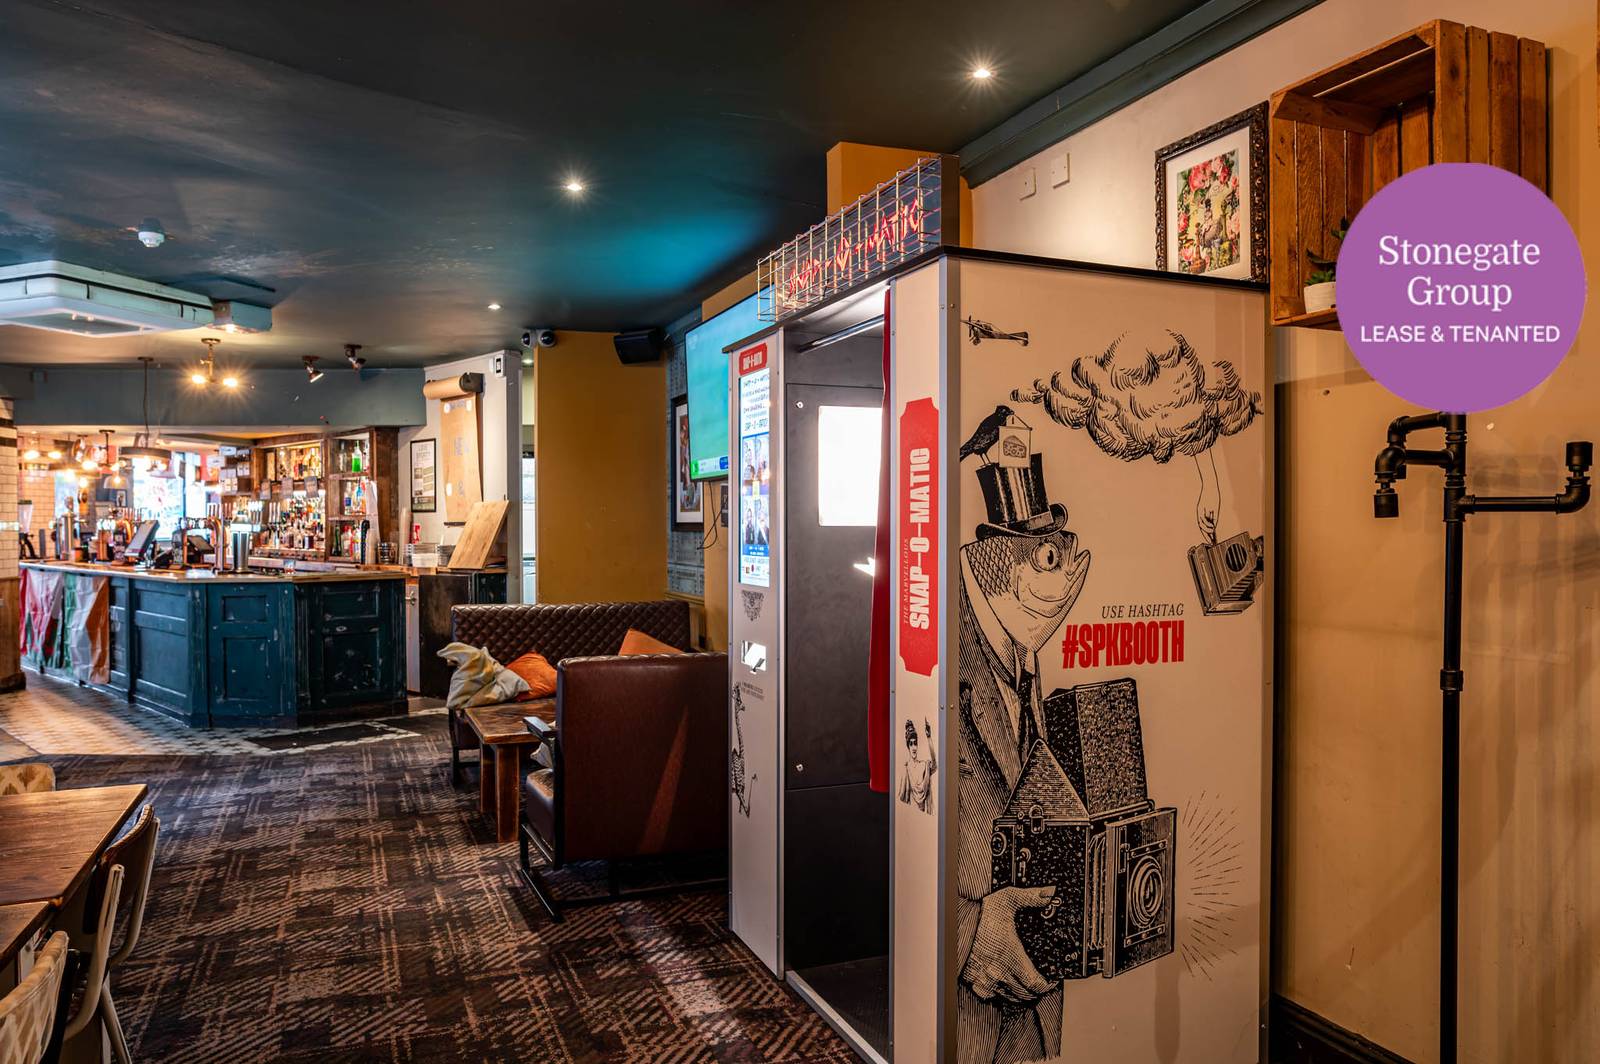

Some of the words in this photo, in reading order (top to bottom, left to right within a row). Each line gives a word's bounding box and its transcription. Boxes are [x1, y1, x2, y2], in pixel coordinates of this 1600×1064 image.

[1102, 606, 1124, 619] USE
[1128, 603, 1183, 617] HASHTAG
[1062, 620, 1184, 668] #SPKBOOTH
